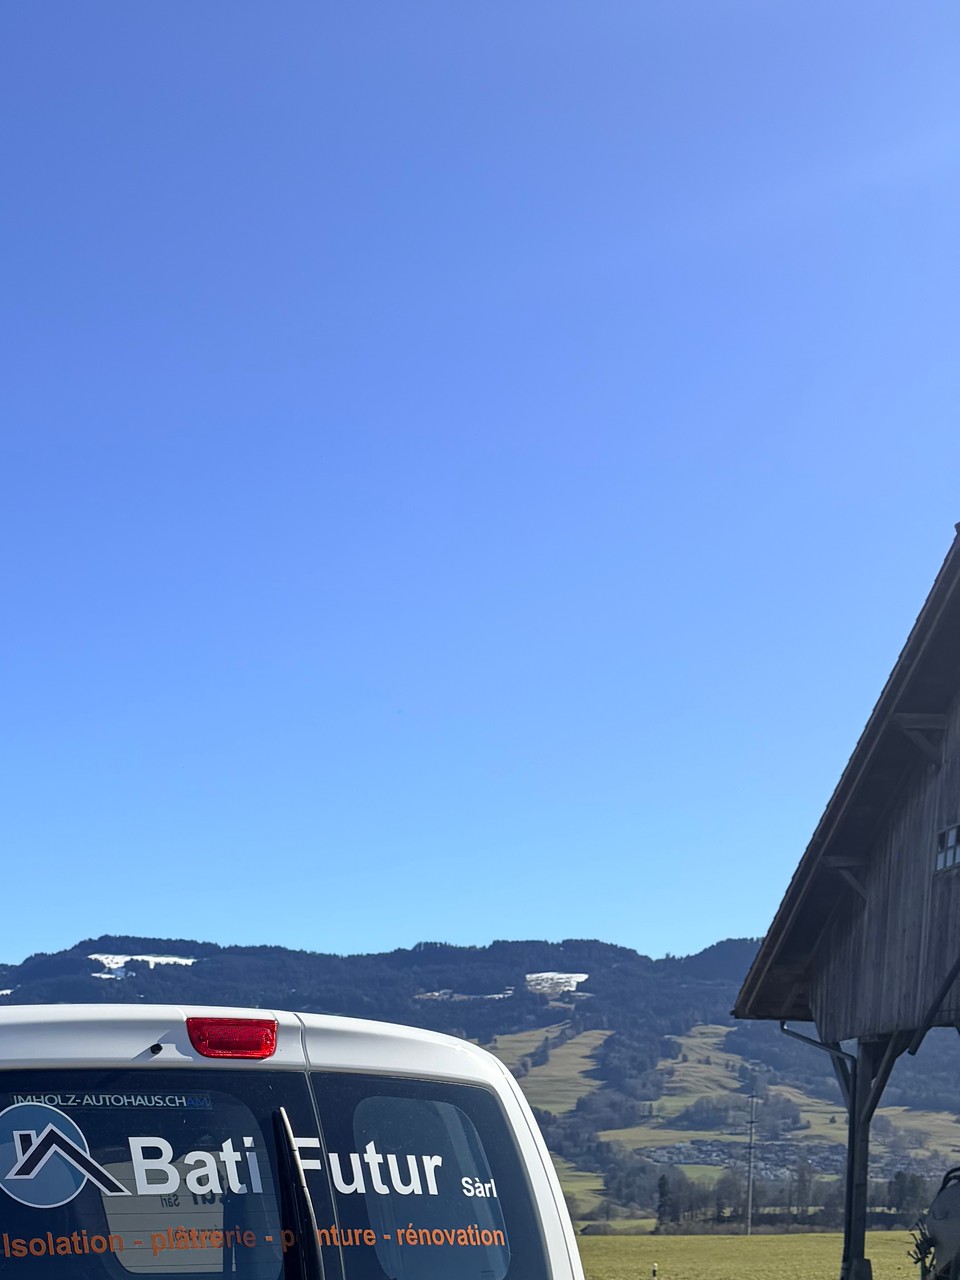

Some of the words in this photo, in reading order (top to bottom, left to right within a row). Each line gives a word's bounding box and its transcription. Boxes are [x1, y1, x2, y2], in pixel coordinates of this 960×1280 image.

[128, 1136, 263, 1195] Bati
[2, 1229, 125, 1258] Isolation
[150, 1225, 257, 1256] plâtrerie
[281, 1223, 376, 1253] pnture
[396, 1222, 505, 1246] rénovation
